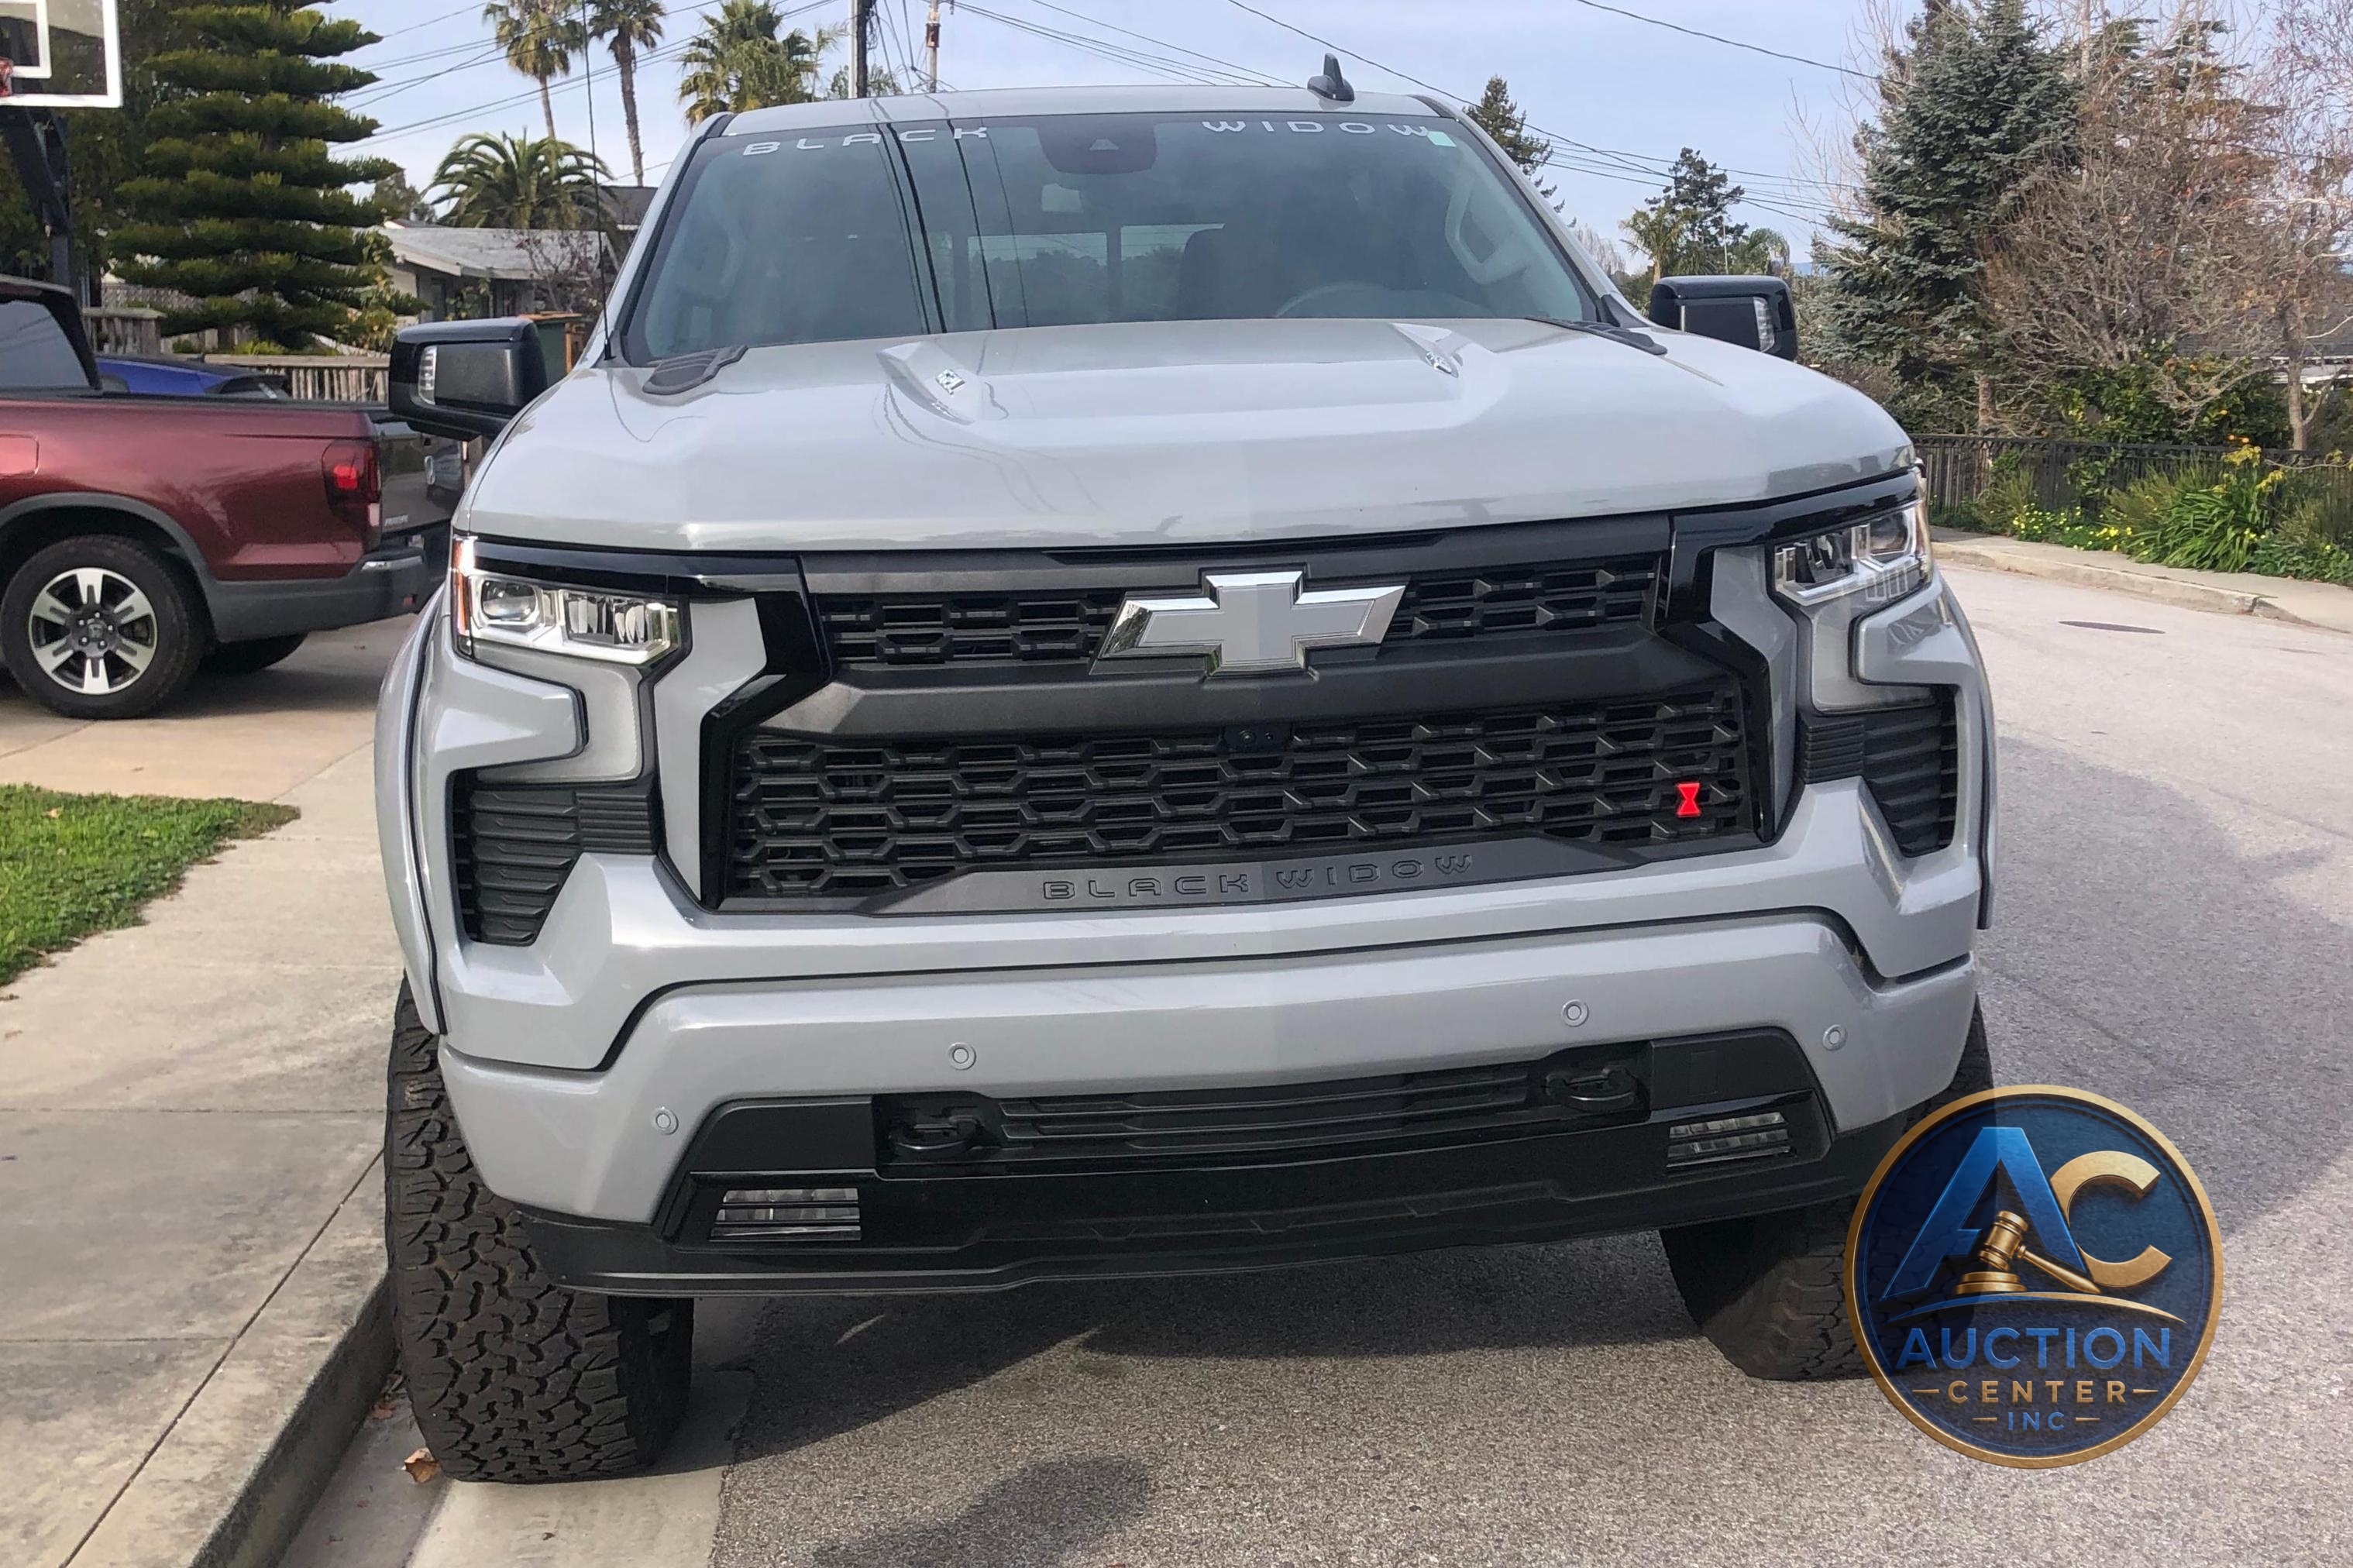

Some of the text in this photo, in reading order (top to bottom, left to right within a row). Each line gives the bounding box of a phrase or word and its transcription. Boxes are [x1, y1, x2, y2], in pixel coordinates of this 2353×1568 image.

[743, 121, 1428, 156] BLACK WIDOW
[1043, 854, 1471, 901] BLACK WIDOW
